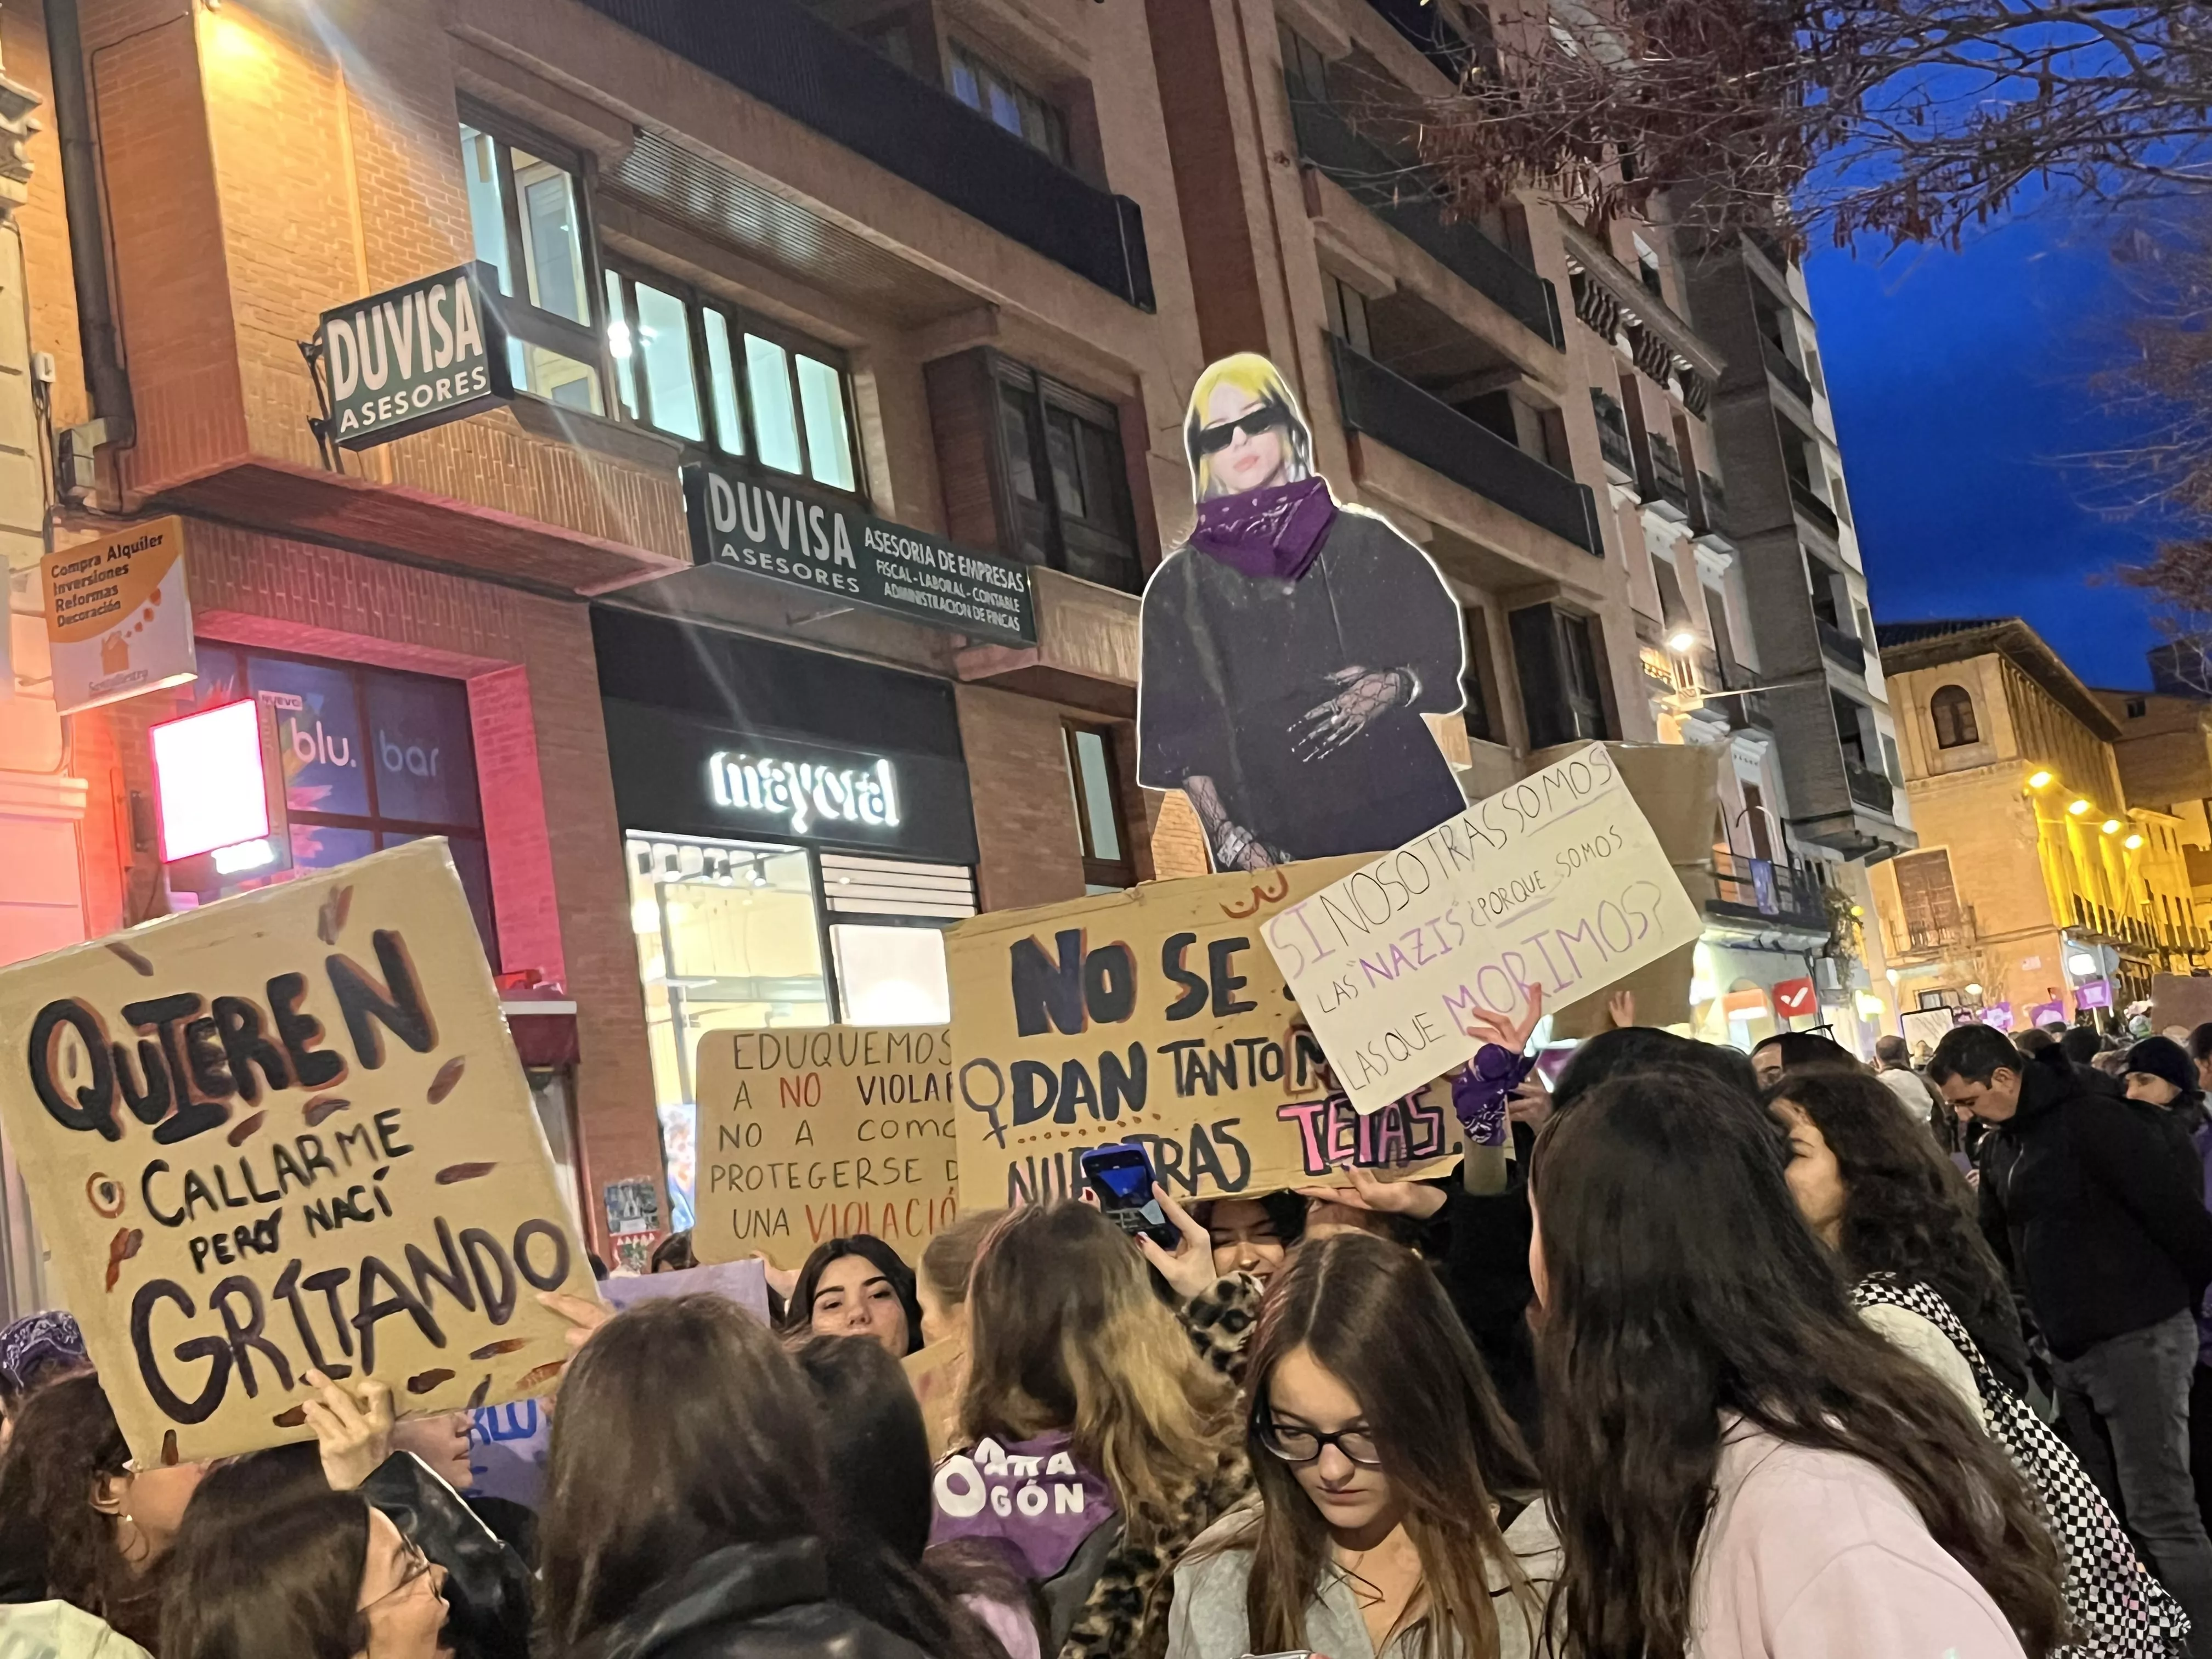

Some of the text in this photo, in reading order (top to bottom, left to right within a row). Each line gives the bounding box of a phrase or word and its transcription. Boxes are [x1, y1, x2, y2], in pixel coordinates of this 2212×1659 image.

[326, 276, 483, 402] DUVISA
[340, 366, 487, 433] ASESORES
[708, 472, 856, 569] DUVISA
[52, 534, 163, 578] Compra Alquiler
[54, 563, 129, 596] Inversiones
[721, 543, 859, 592] ASESORES
[865, 527, 1024, 592] ASESORIA DE EMPRESAS
[55, 585, 119, 613] Reformas
[58, 600, 121, 627] Decoración
[973, 606, 986, 622] DE
[986, 609, 1020, 631] FINCAS
[380, 729, 439, 777] bar
[1268, 747, 1612, 980] SI NOSOTRAS SOMOS
[1317, 974, 1359, 1014] LAS
[1556, 825, 1623, 878] SOMOS
[1010, 927, 1257, 1037] NO SE
[1338, 1041, 1388, 1091] LAS
[1385, 1012, 1447, 1062] QUE
[1441, 880, 1664, 1035] MORIMOS?
[29, 928, 439, 1146] QUIEREN
[733, 1029, 951, 1070] EDUQUEMOS
[733, 1080, 752, 1111] A
[779, 1072, 821, 1108] NO
[1011, 1041, 1148, 1127] DAN
[1158, 1036, 1284, 1097] TANTO
[719, 1123, 762, 1152] NO
[795, 1120, 814, 1147] A
[141, 1108, 415, 1227] CALLARME
[711, 1156, 922, 1193] PROTEGERSE
[304, 1166, 392, 1238] NACÍ
[732, 1187, 956, 1243] UNA VIOLACIÓ
